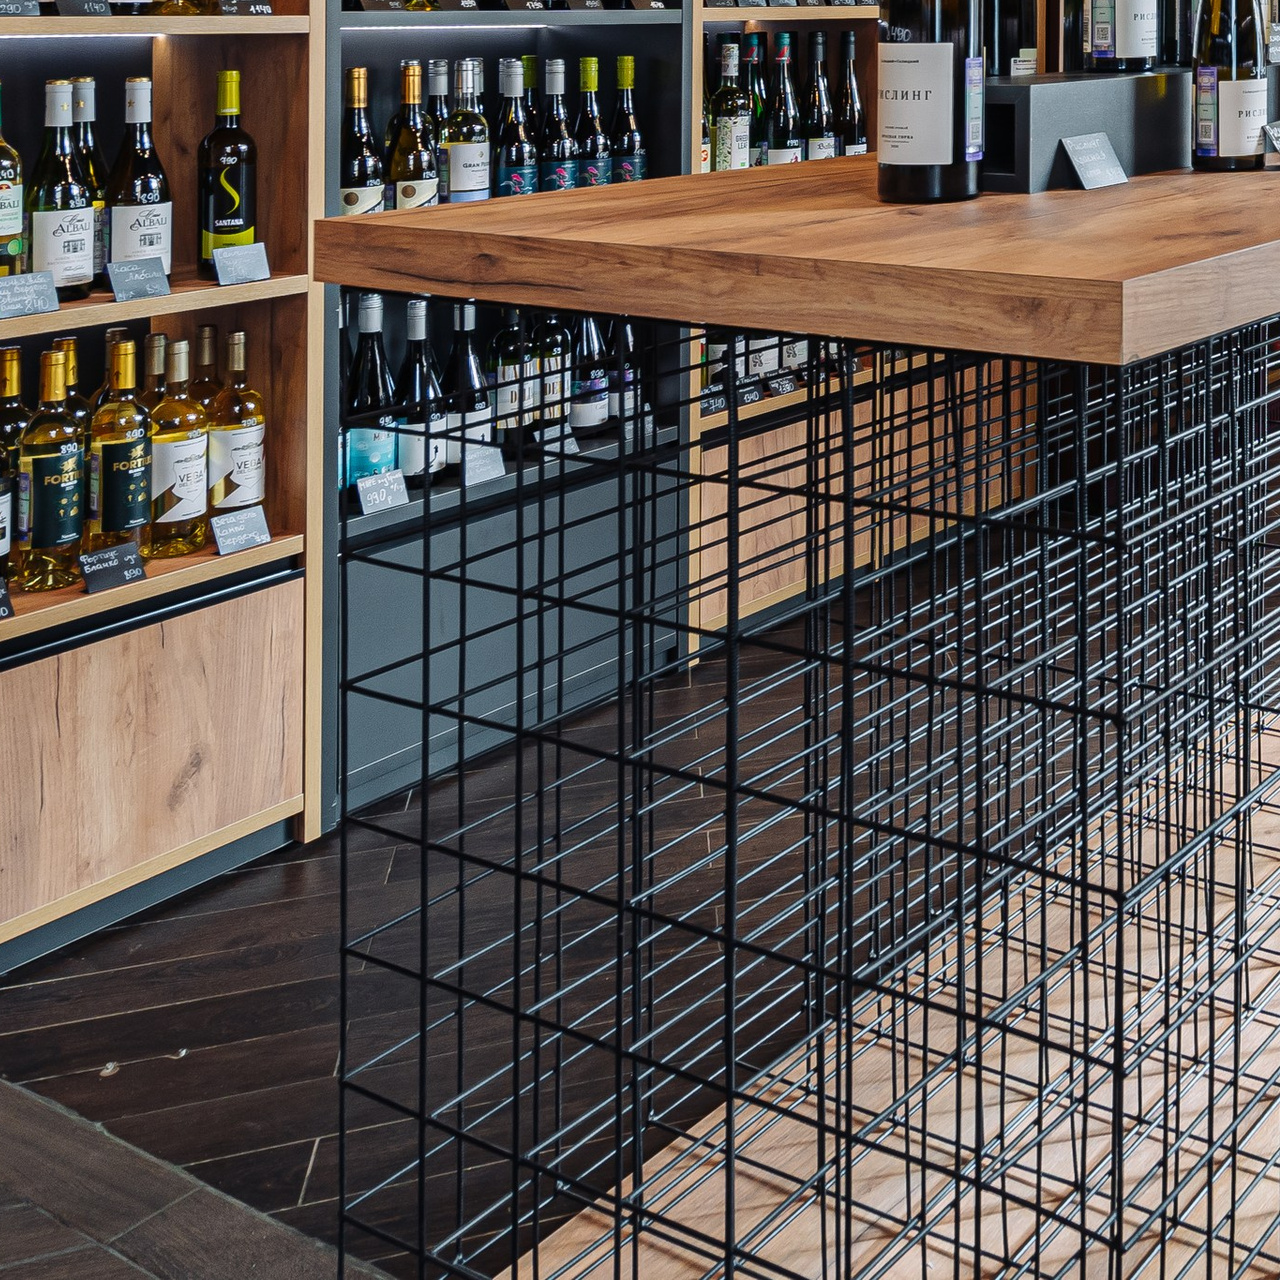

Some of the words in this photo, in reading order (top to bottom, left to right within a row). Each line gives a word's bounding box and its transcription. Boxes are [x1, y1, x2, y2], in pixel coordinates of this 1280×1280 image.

[84, 2, 106, 13] 1140
[249, 4, 272, 14] 1140
[878, 89, 932, 102] ИСЛИНГ
[130, 216, 168, 231] ALBALI
[214, 218, 244, 227] SANTANA
[53, 222, 90, 237] ALBALI
[60, 442, 78, 454] 890
[366, 489, 386, 506] 990
[123, 568, 142, 580] 890
